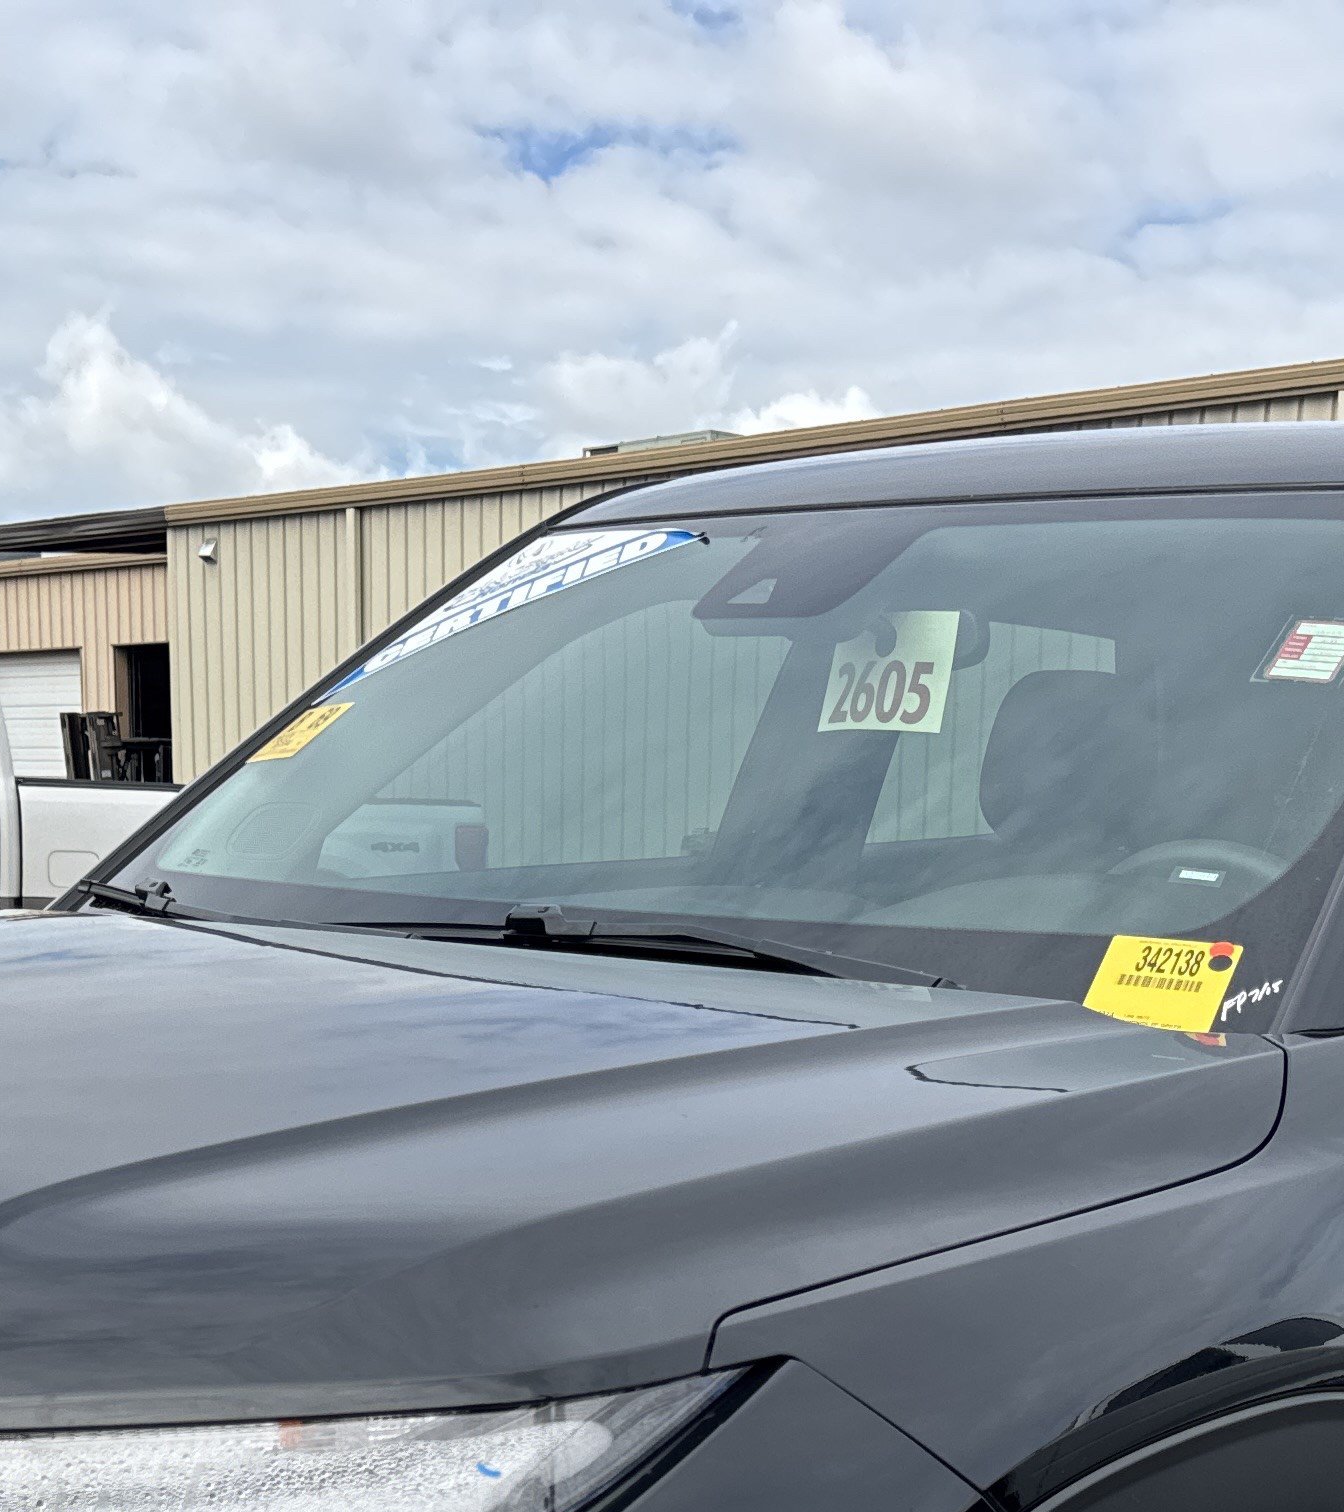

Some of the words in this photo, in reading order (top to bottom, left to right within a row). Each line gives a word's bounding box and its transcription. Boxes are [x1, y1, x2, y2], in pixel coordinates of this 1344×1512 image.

[364, 533, 667, 673] CERTIFIED
[828, 660, 934, 724] 2605
[1135, 945, 1205, 977] 342138
